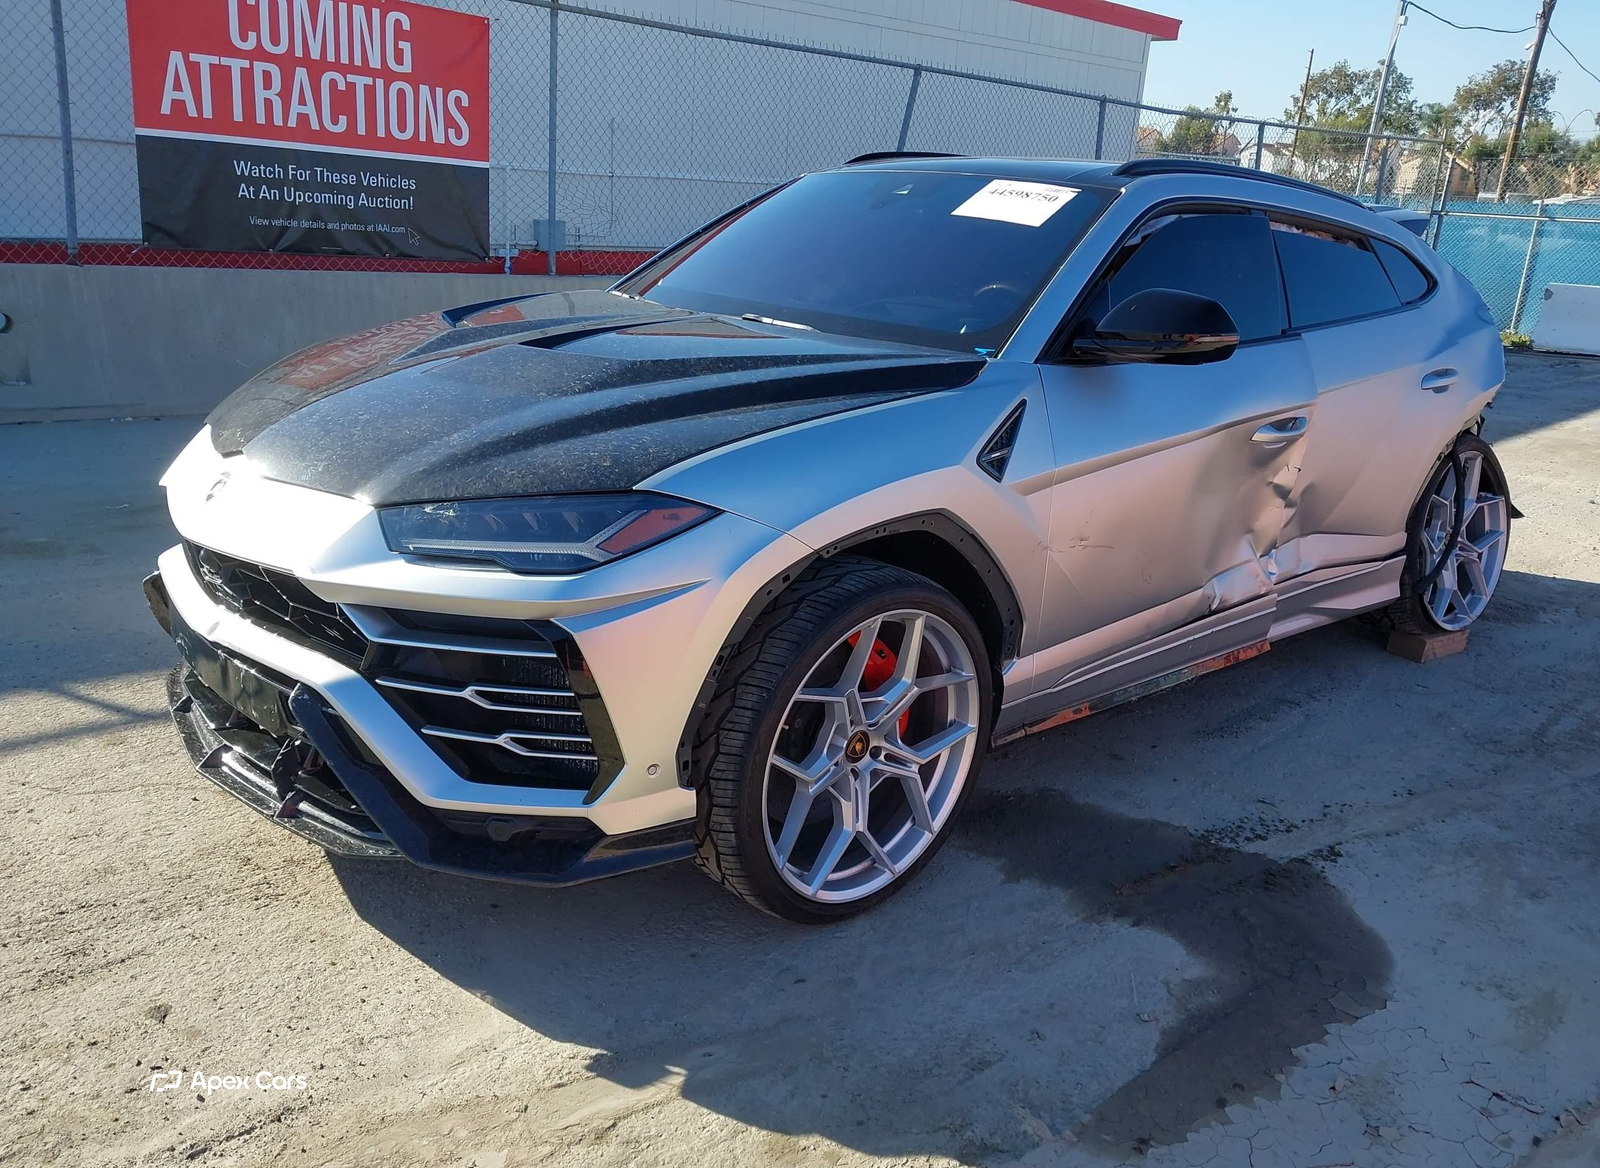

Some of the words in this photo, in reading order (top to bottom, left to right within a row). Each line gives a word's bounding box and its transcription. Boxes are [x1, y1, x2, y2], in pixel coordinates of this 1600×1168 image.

[228, 0, 412, 73] COMING
[160, 50, 470, 147] ATTRACTIONS
[233, 160, 283, 179] Watch
[288, 165, 311, 181] For
[314, 167, 357, 185] These
[360, 171, 416, 190] Vehicles
[237, 183, 255, 200] At
[259, 184, 279, 201] An
[283, 186, 354, 209] Upcoming
[358, 192, 414, 210] Auction!
[988, 188, 1059, 203] 44598750
[249, 216, 270, 226] View
[271, 217, 298, 227] vehicle
[300, 219, 325, 229] details
[327, 221, 340, 230] and
[341, 222, 365, 232] photos
[366, 224, 374, 232] at
[375, 224, 406, 233] IAAI.com
